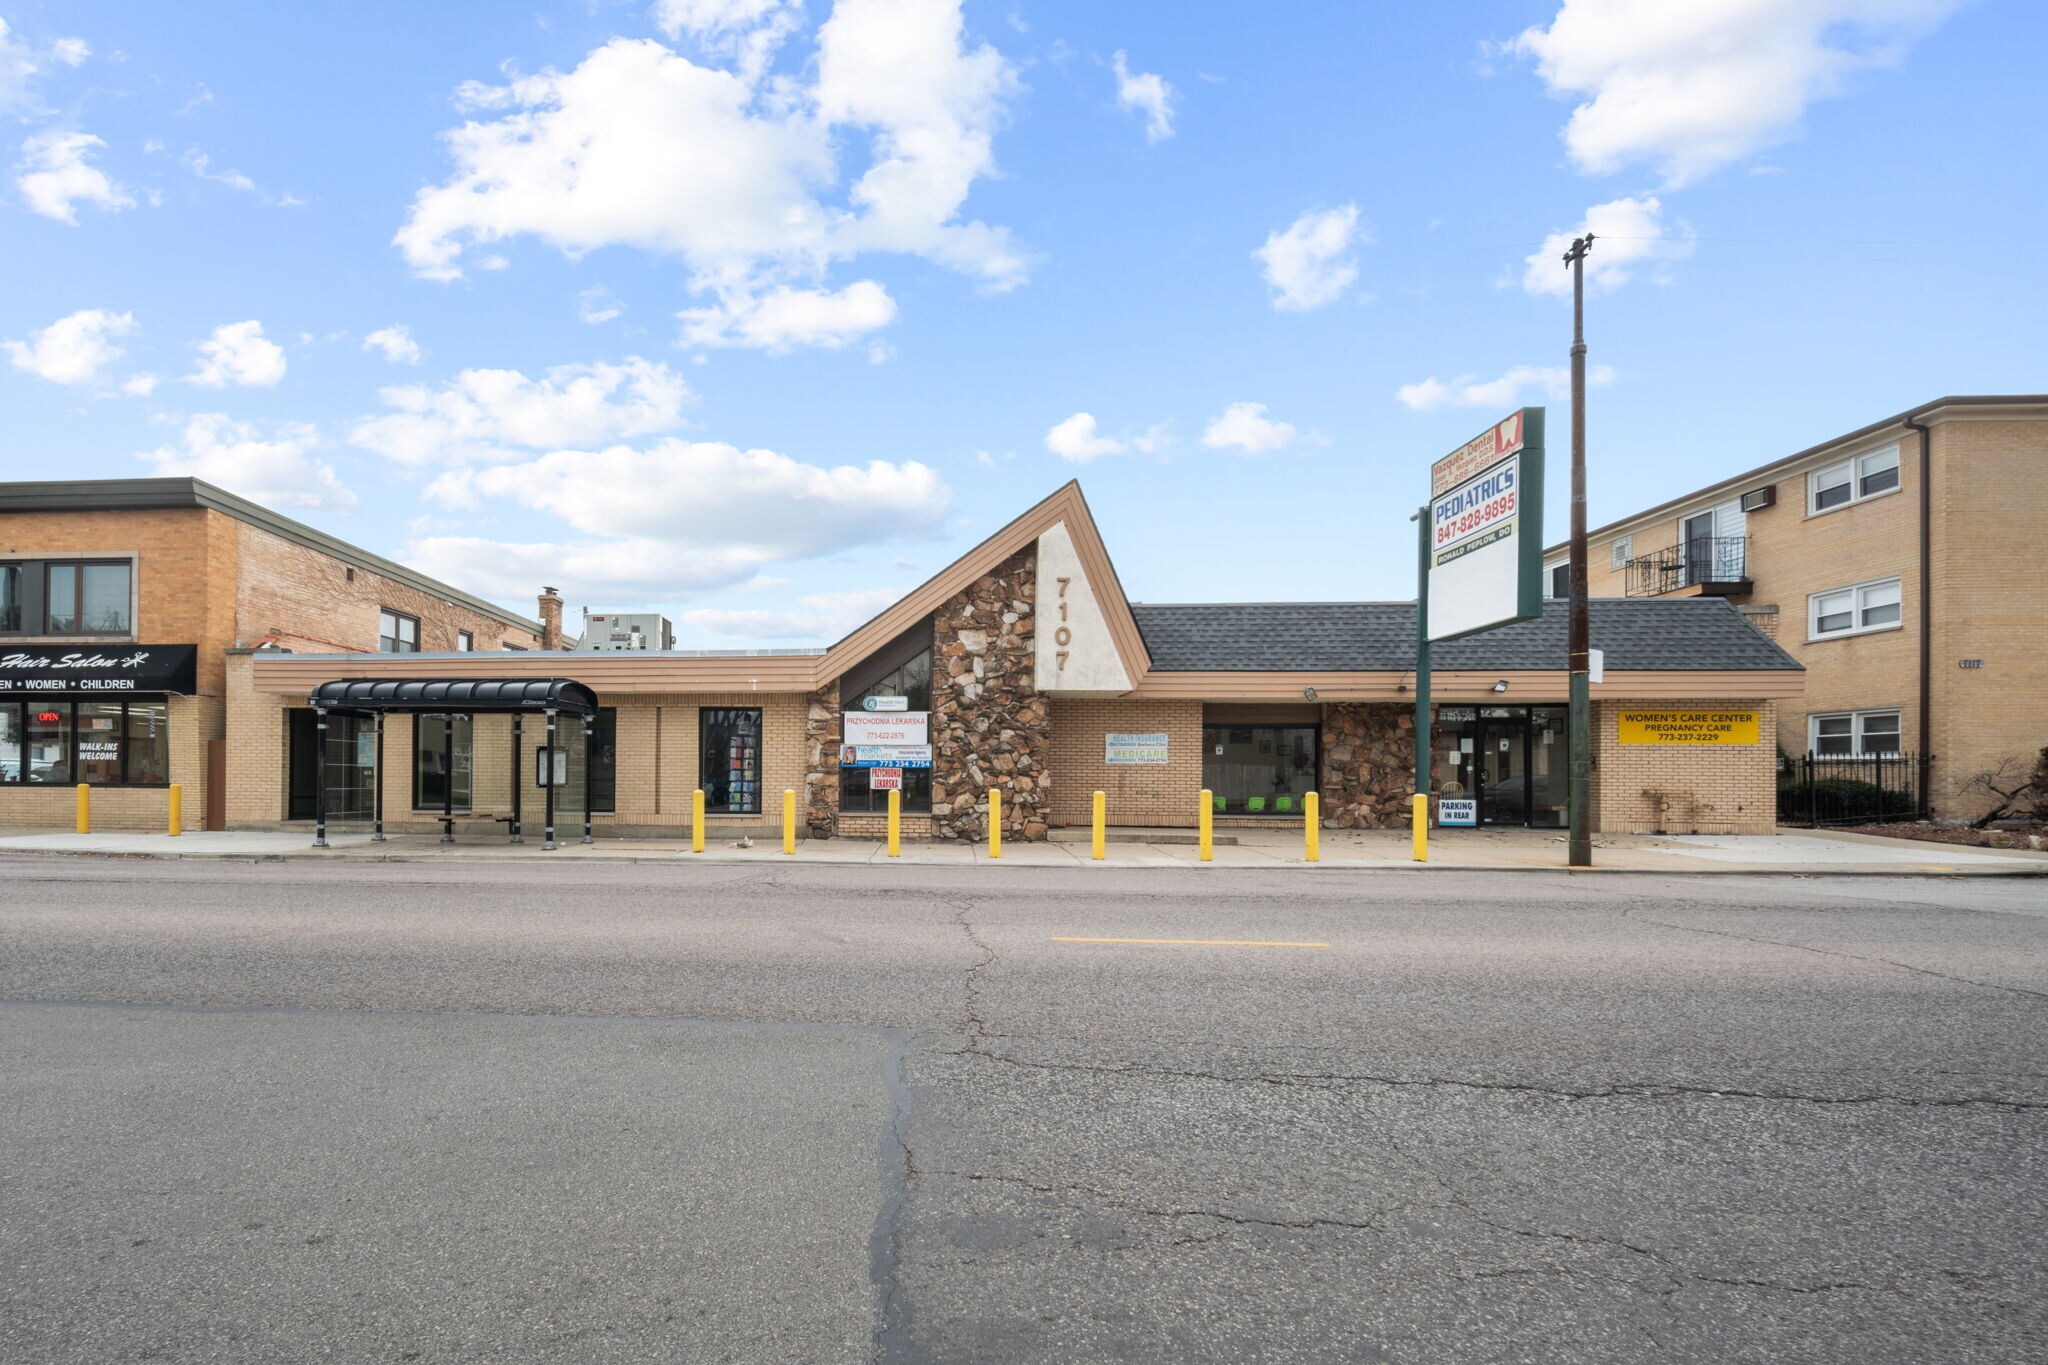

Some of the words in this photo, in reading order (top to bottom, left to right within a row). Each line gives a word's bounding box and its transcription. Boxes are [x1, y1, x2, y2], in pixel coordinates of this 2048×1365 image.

[1433, 452, 1464, 476] Vazquez
[1467, 430, 1494, 456] Dental
[1436, 466, 1514, 524] PEDIATRICS
[1437, 492, 1515, 544] 847-828-9895
[1438, 546, 1465, 564] RONALD
[1466, 532, 1497, 552] PEPLOW,
[1498, 526, 1511, 538] DO
[1055, 577, 1072, 671] 7107
[0, 653, 51, 669] Hair
[51, 653, 118, 669] Salon
[25, 679, 67, 689] WOMEN
[80, 679, 135, 689] CHILDREN
[38, 712, 59, 722] OPEN
[846, 717, 891, 726] PRZYCHODNIA
[891, 717, 926, 726] LEKARSKA
[1624, 713, 1678, 723] WOMEN'S
[1680, 713, 1708, 723] CARE
[1710, 713, 1753, 723] CENTER
[1644, 723, 1704, 732] PREGNANCY
[1706, 723, 1733, 732] CARE
[1658, 733, 1719, 741] 773-237-2229
[79, 742, 118, 751] WALK-INS
[857, 745, 882, 755] health
[79, 752, 118, 761] WELCOME
[1113, 750, 1167, 758] MEDICARE
[874, 779, 899, 788] LEKARSKA
[1441, 801, 1473, 810] PARKING
[1444, 811, 1452, 819] IN
[1453, 811, 1470, 819] REAR
